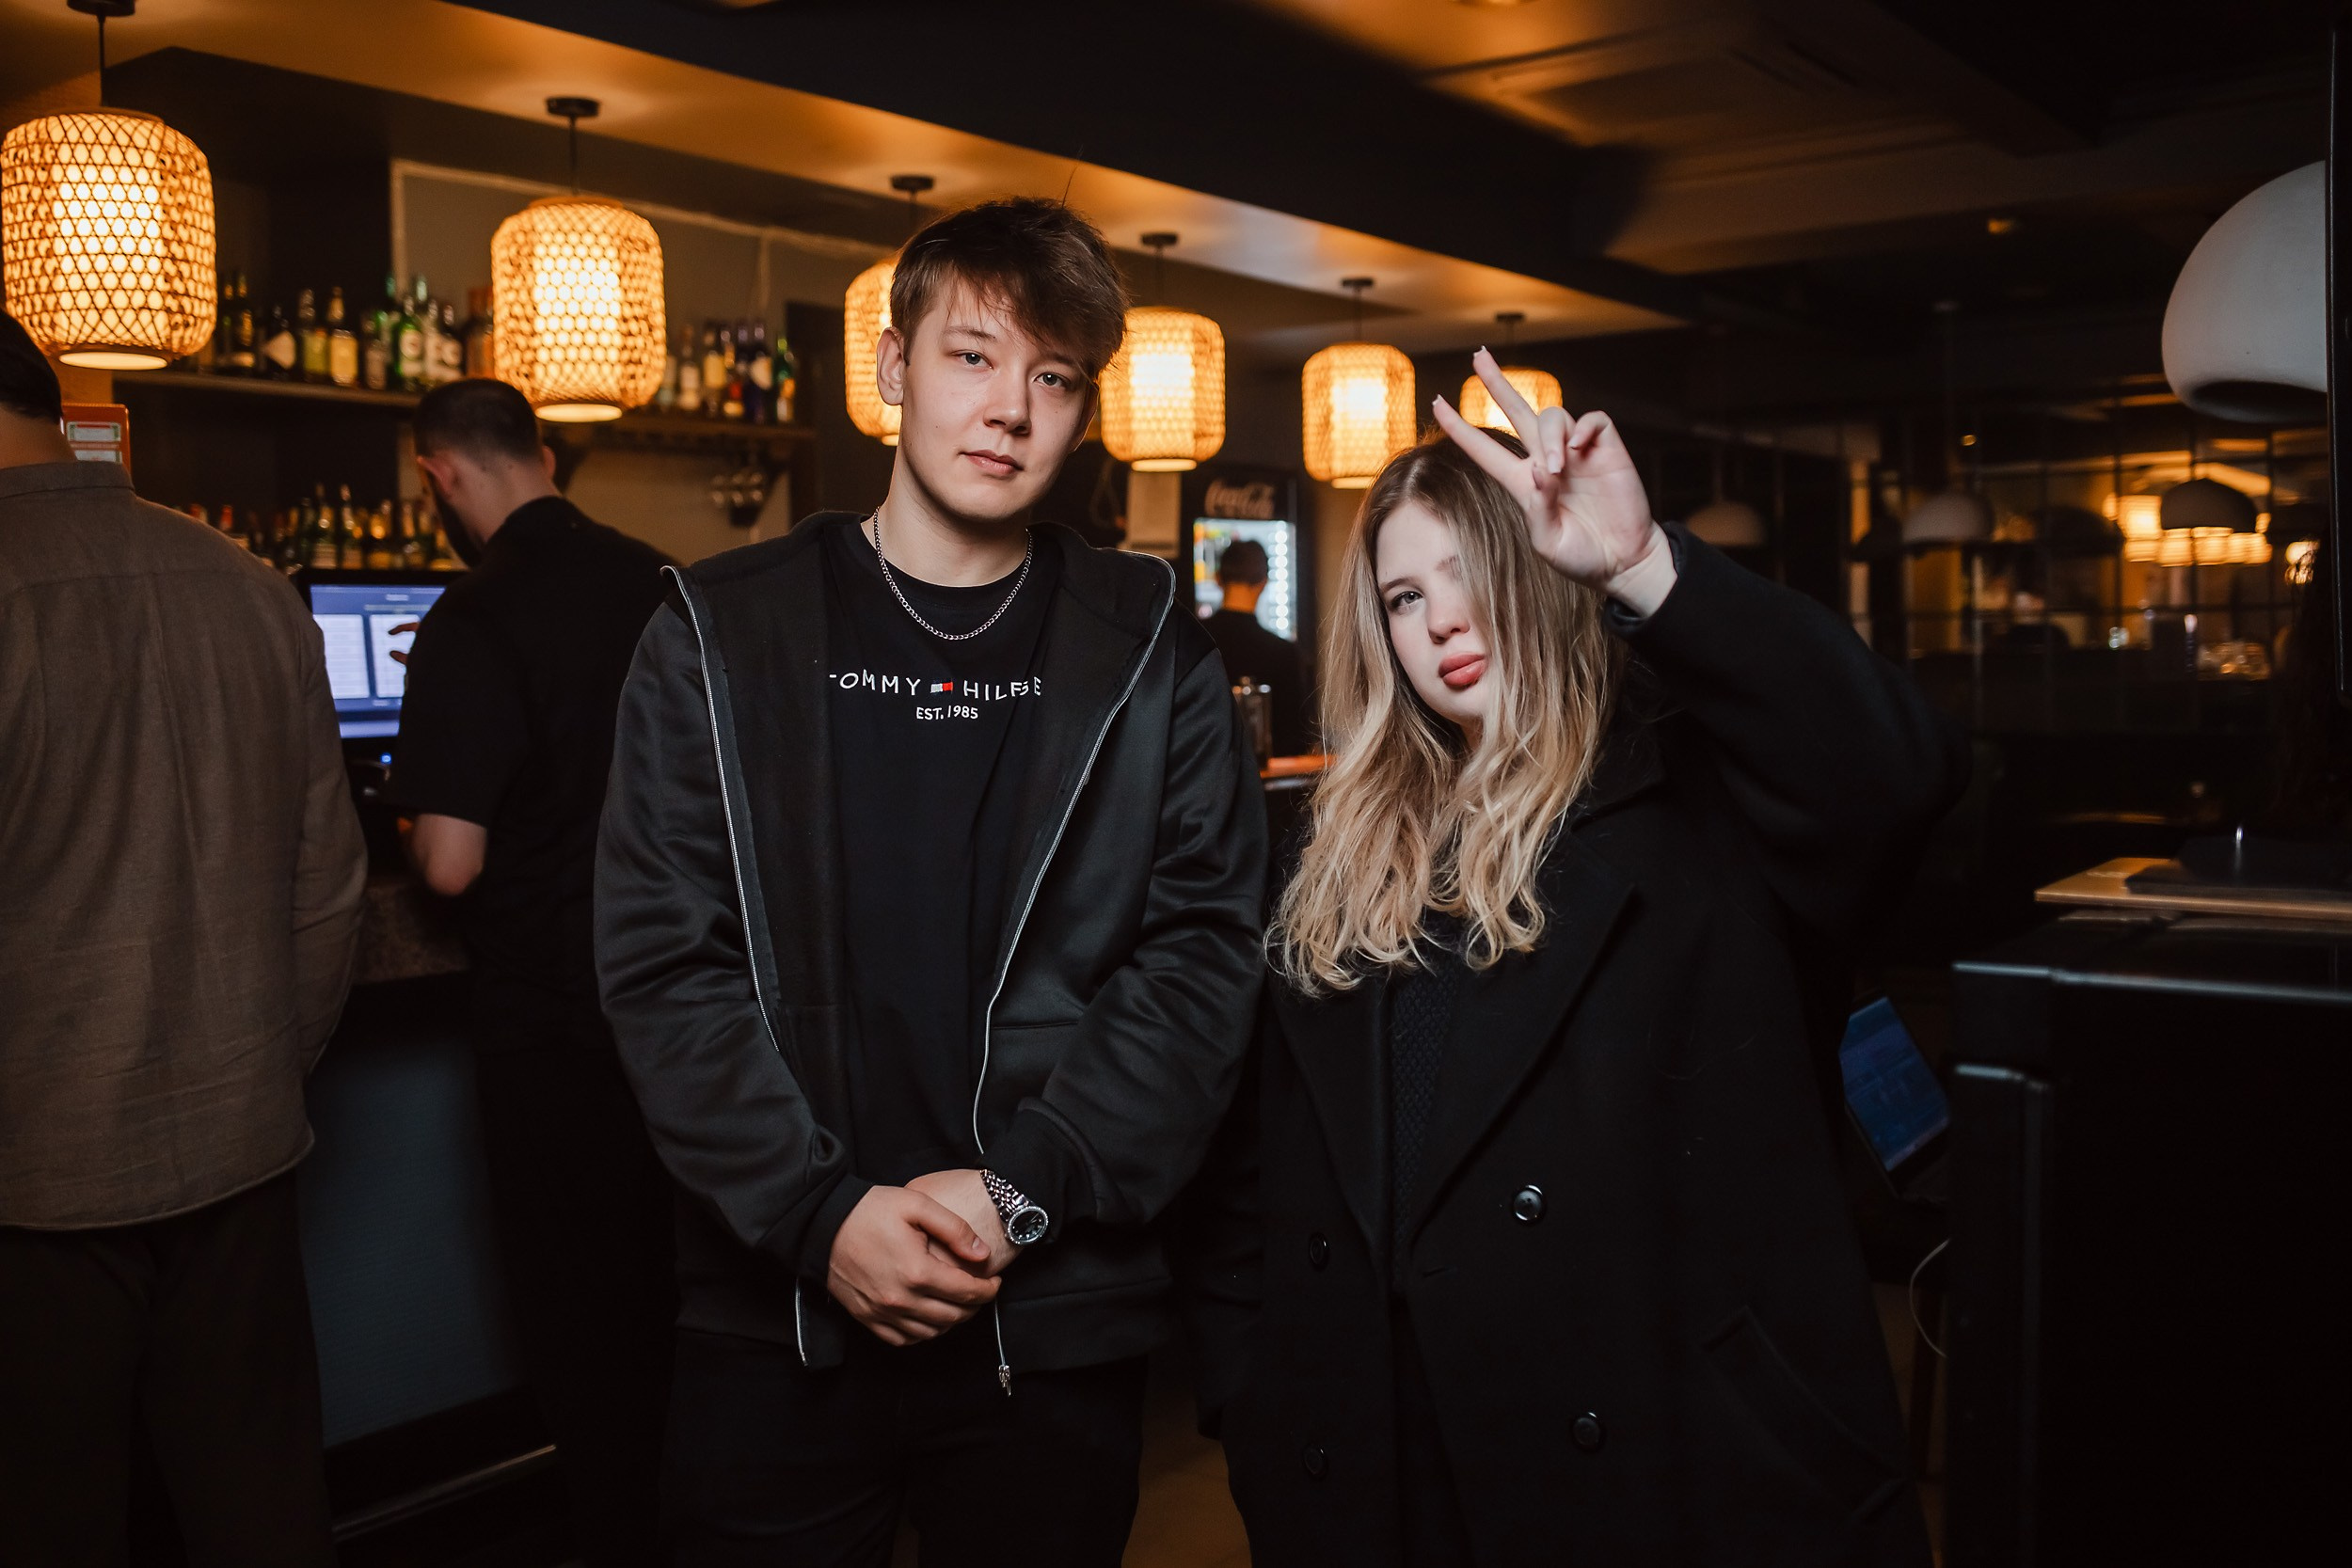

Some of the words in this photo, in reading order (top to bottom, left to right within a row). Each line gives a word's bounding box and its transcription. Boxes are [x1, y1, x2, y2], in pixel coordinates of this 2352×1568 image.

[829, 669, 921, 696] OMMY
[915, 706, 944, 721] EST.
[946, 705, 978, 720] 1985
